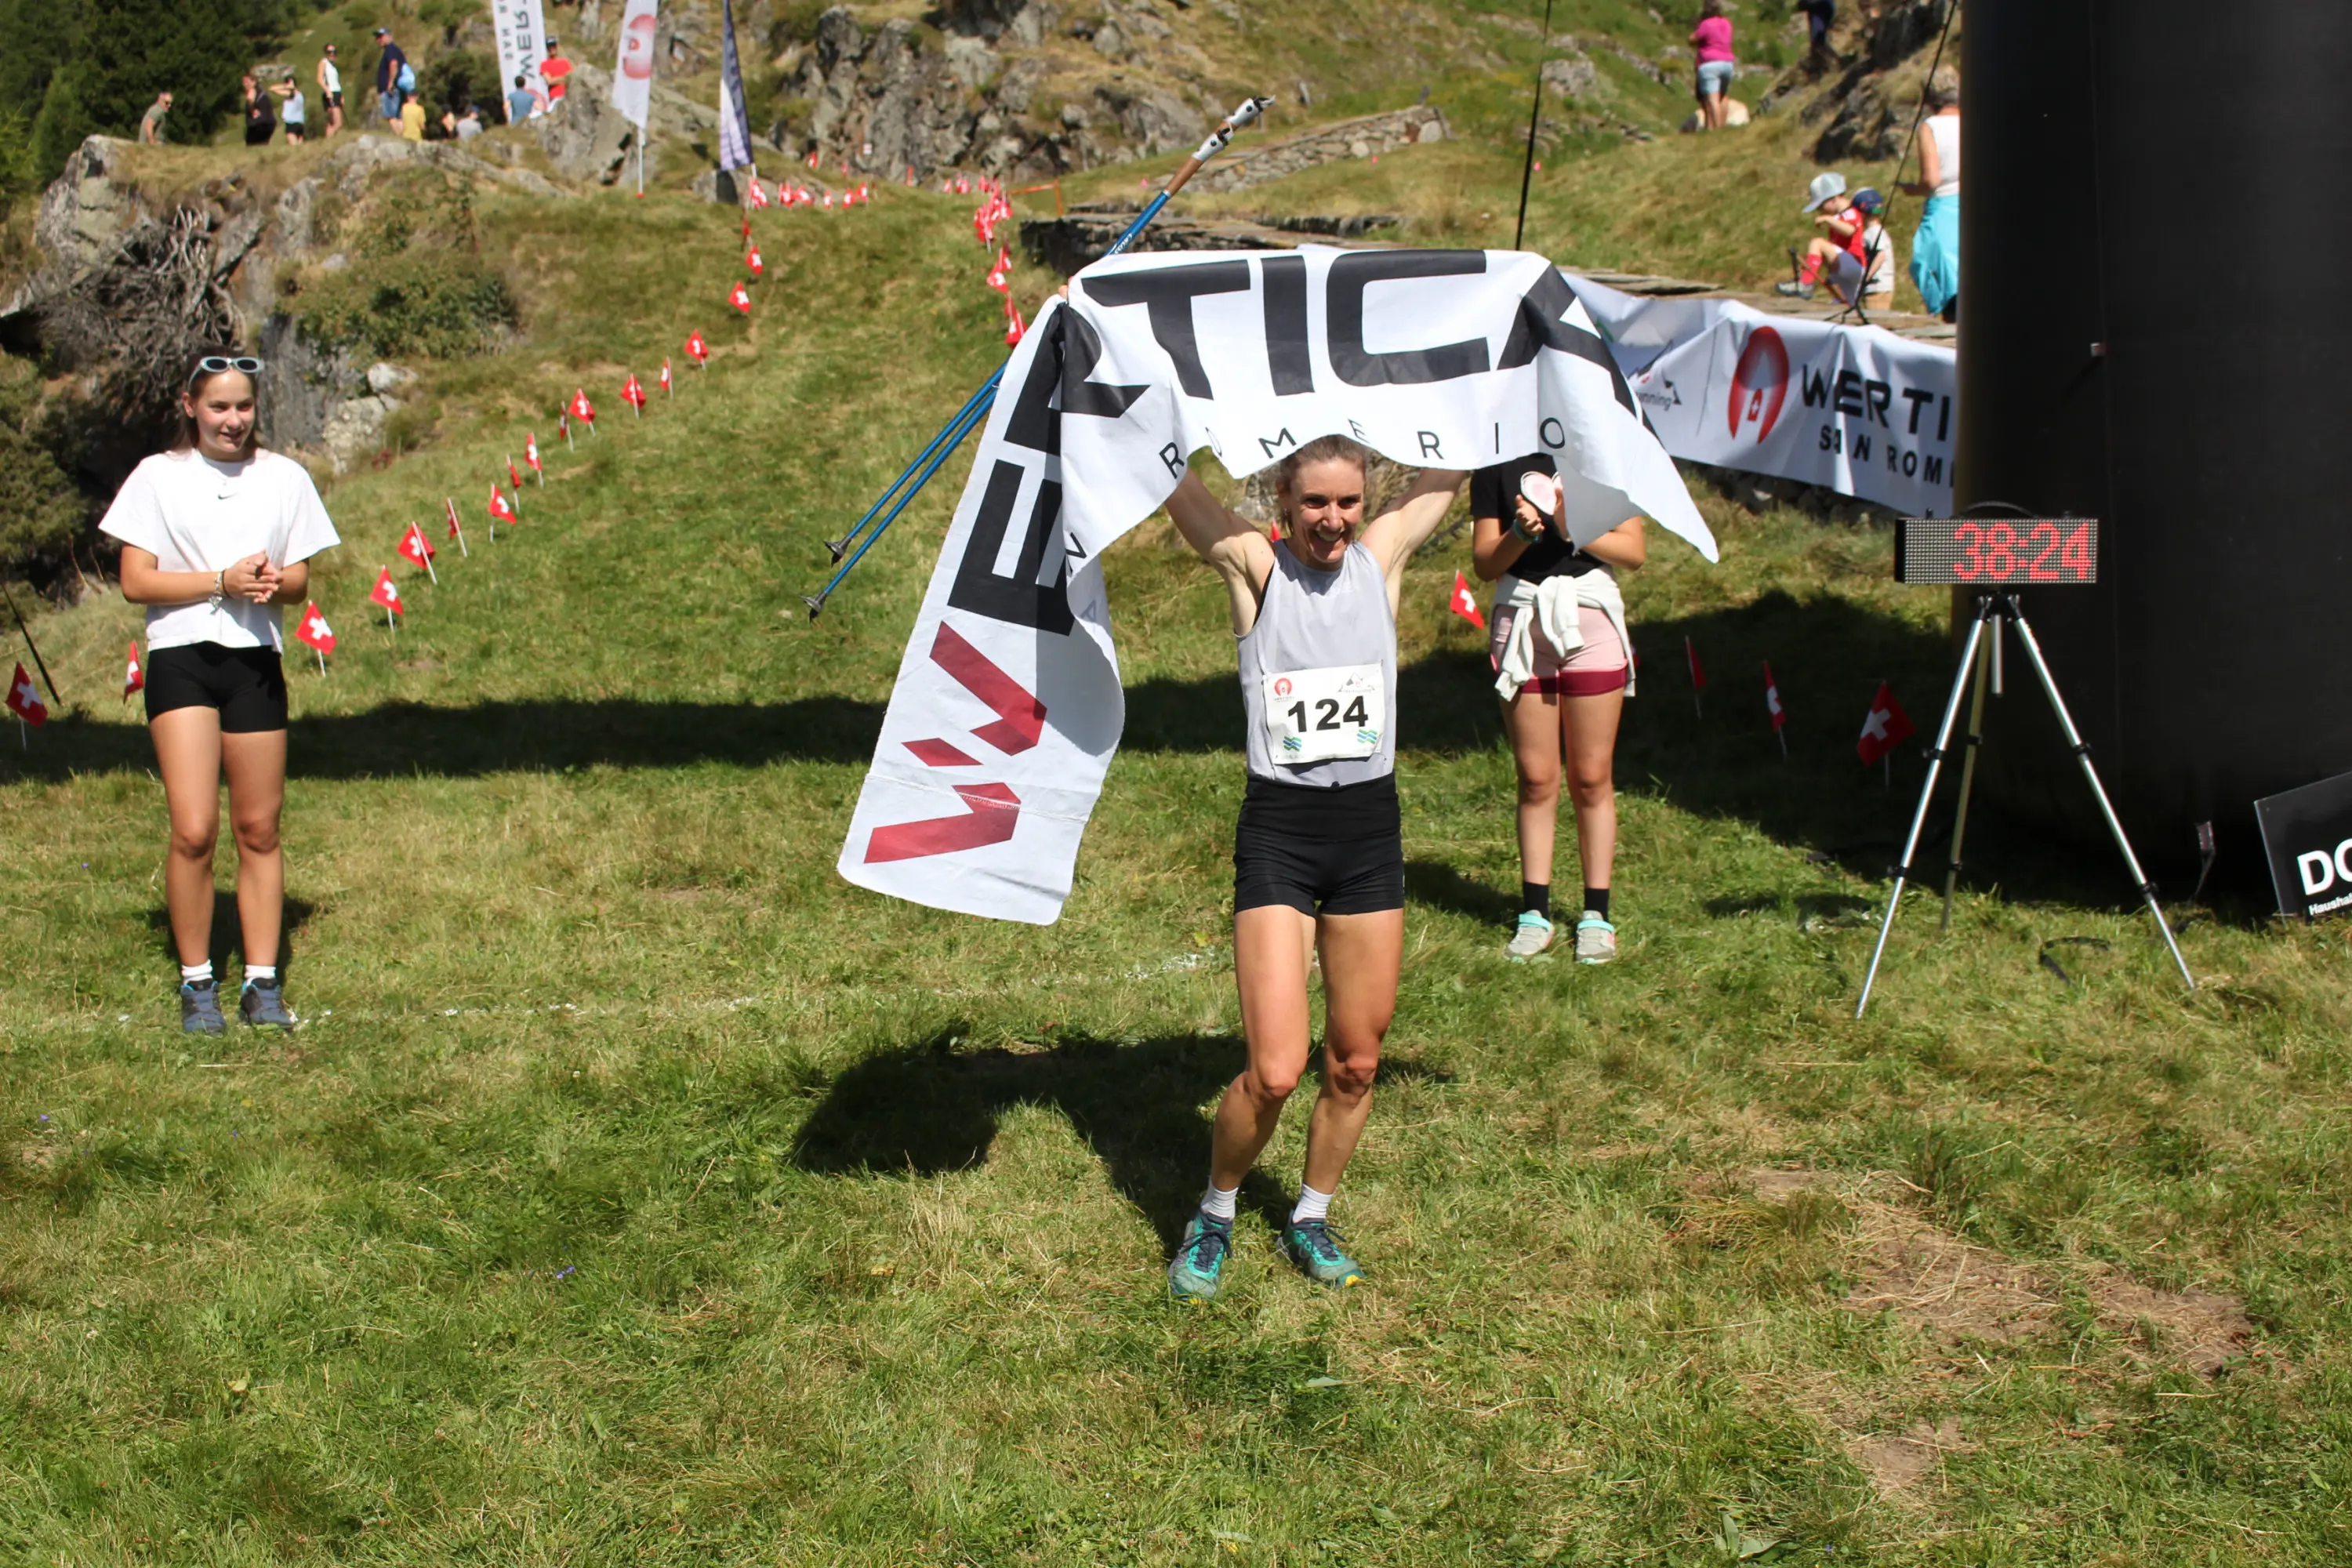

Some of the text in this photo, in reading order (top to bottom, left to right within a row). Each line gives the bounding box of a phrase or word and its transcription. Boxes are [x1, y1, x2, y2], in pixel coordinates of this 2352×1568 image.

[1802, 363, 1951, 442] WERTI
[1159, 417, 1566, 479] ROMERIO
[1953, 521, 2092, 580] 38:24
[1287, 695, 1369, 733] 124
